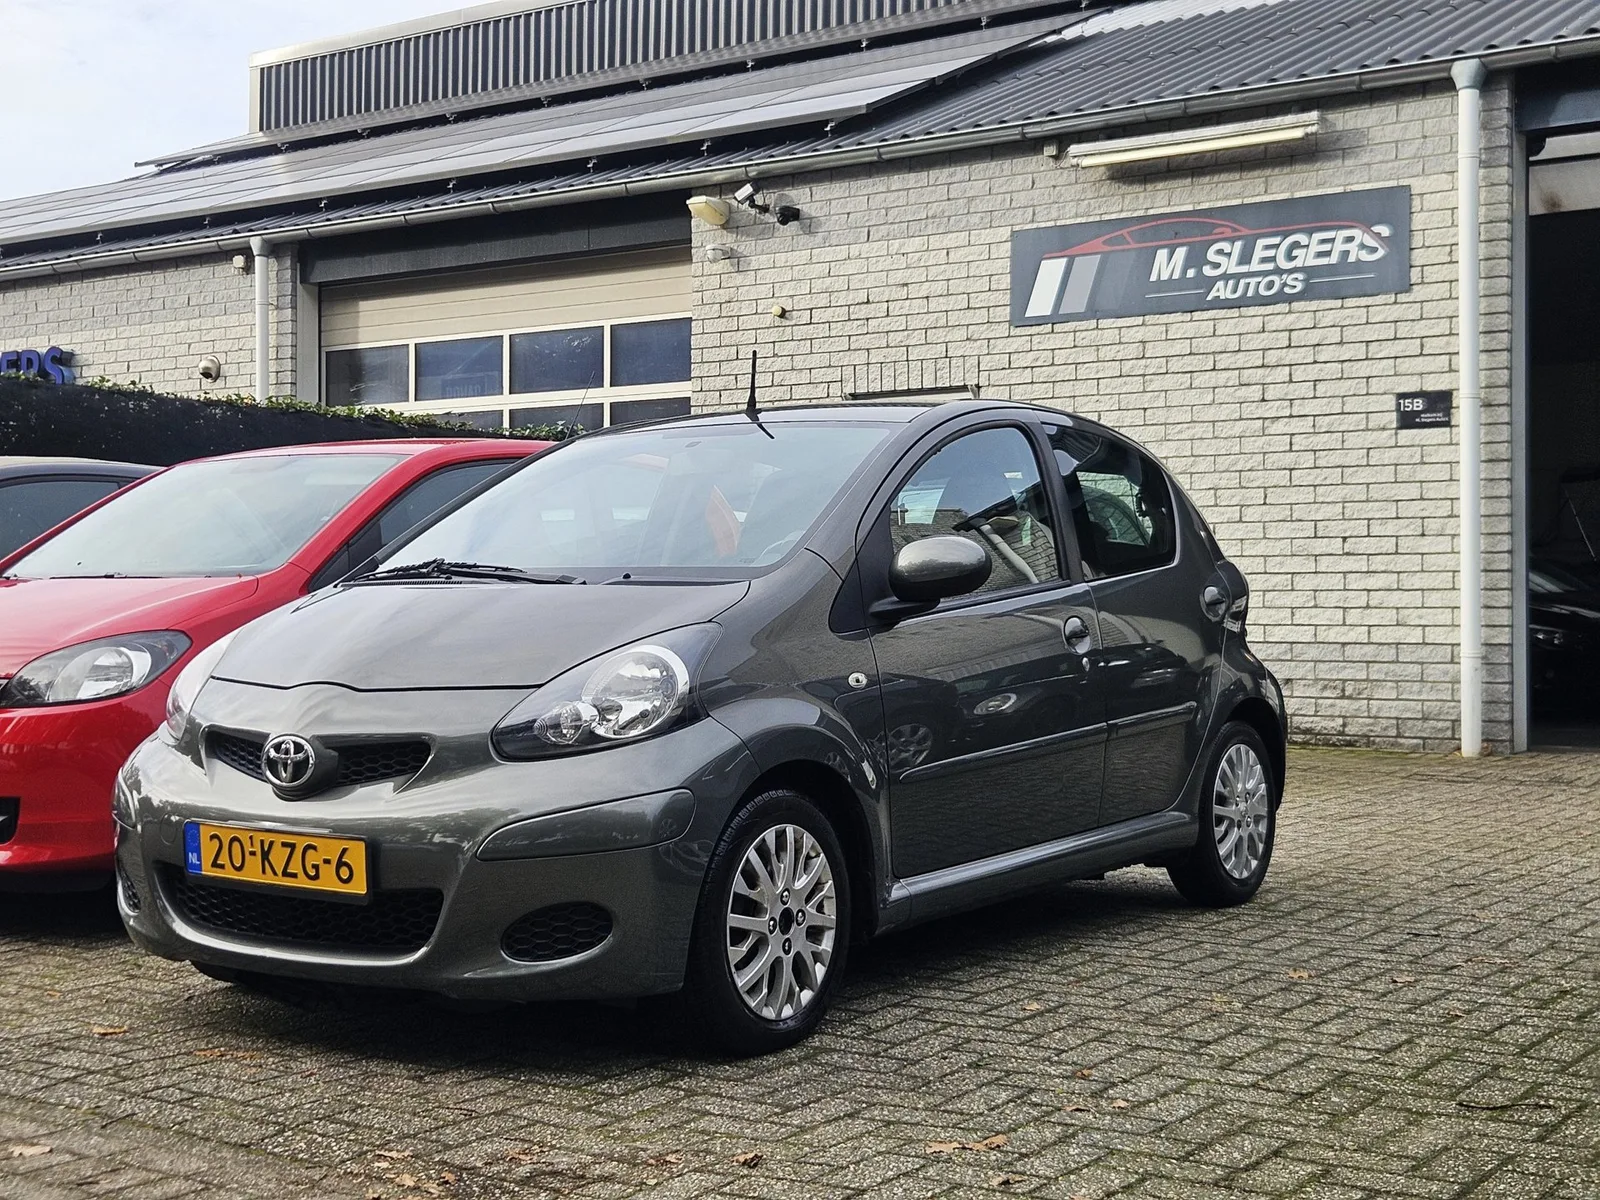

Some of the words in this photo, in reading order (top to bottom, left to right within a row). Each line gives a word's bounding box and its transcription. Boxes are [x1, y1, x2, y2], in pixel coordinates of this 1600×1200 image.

[1149, 245, 1197, 282] M.
[1202, 225, 1391, 277] SLEGERS
[1205, 273, 1305, 300] AUTO'S
[1398, 398, 1423, 411] 15B
[188, 852, 200, 864] NL
